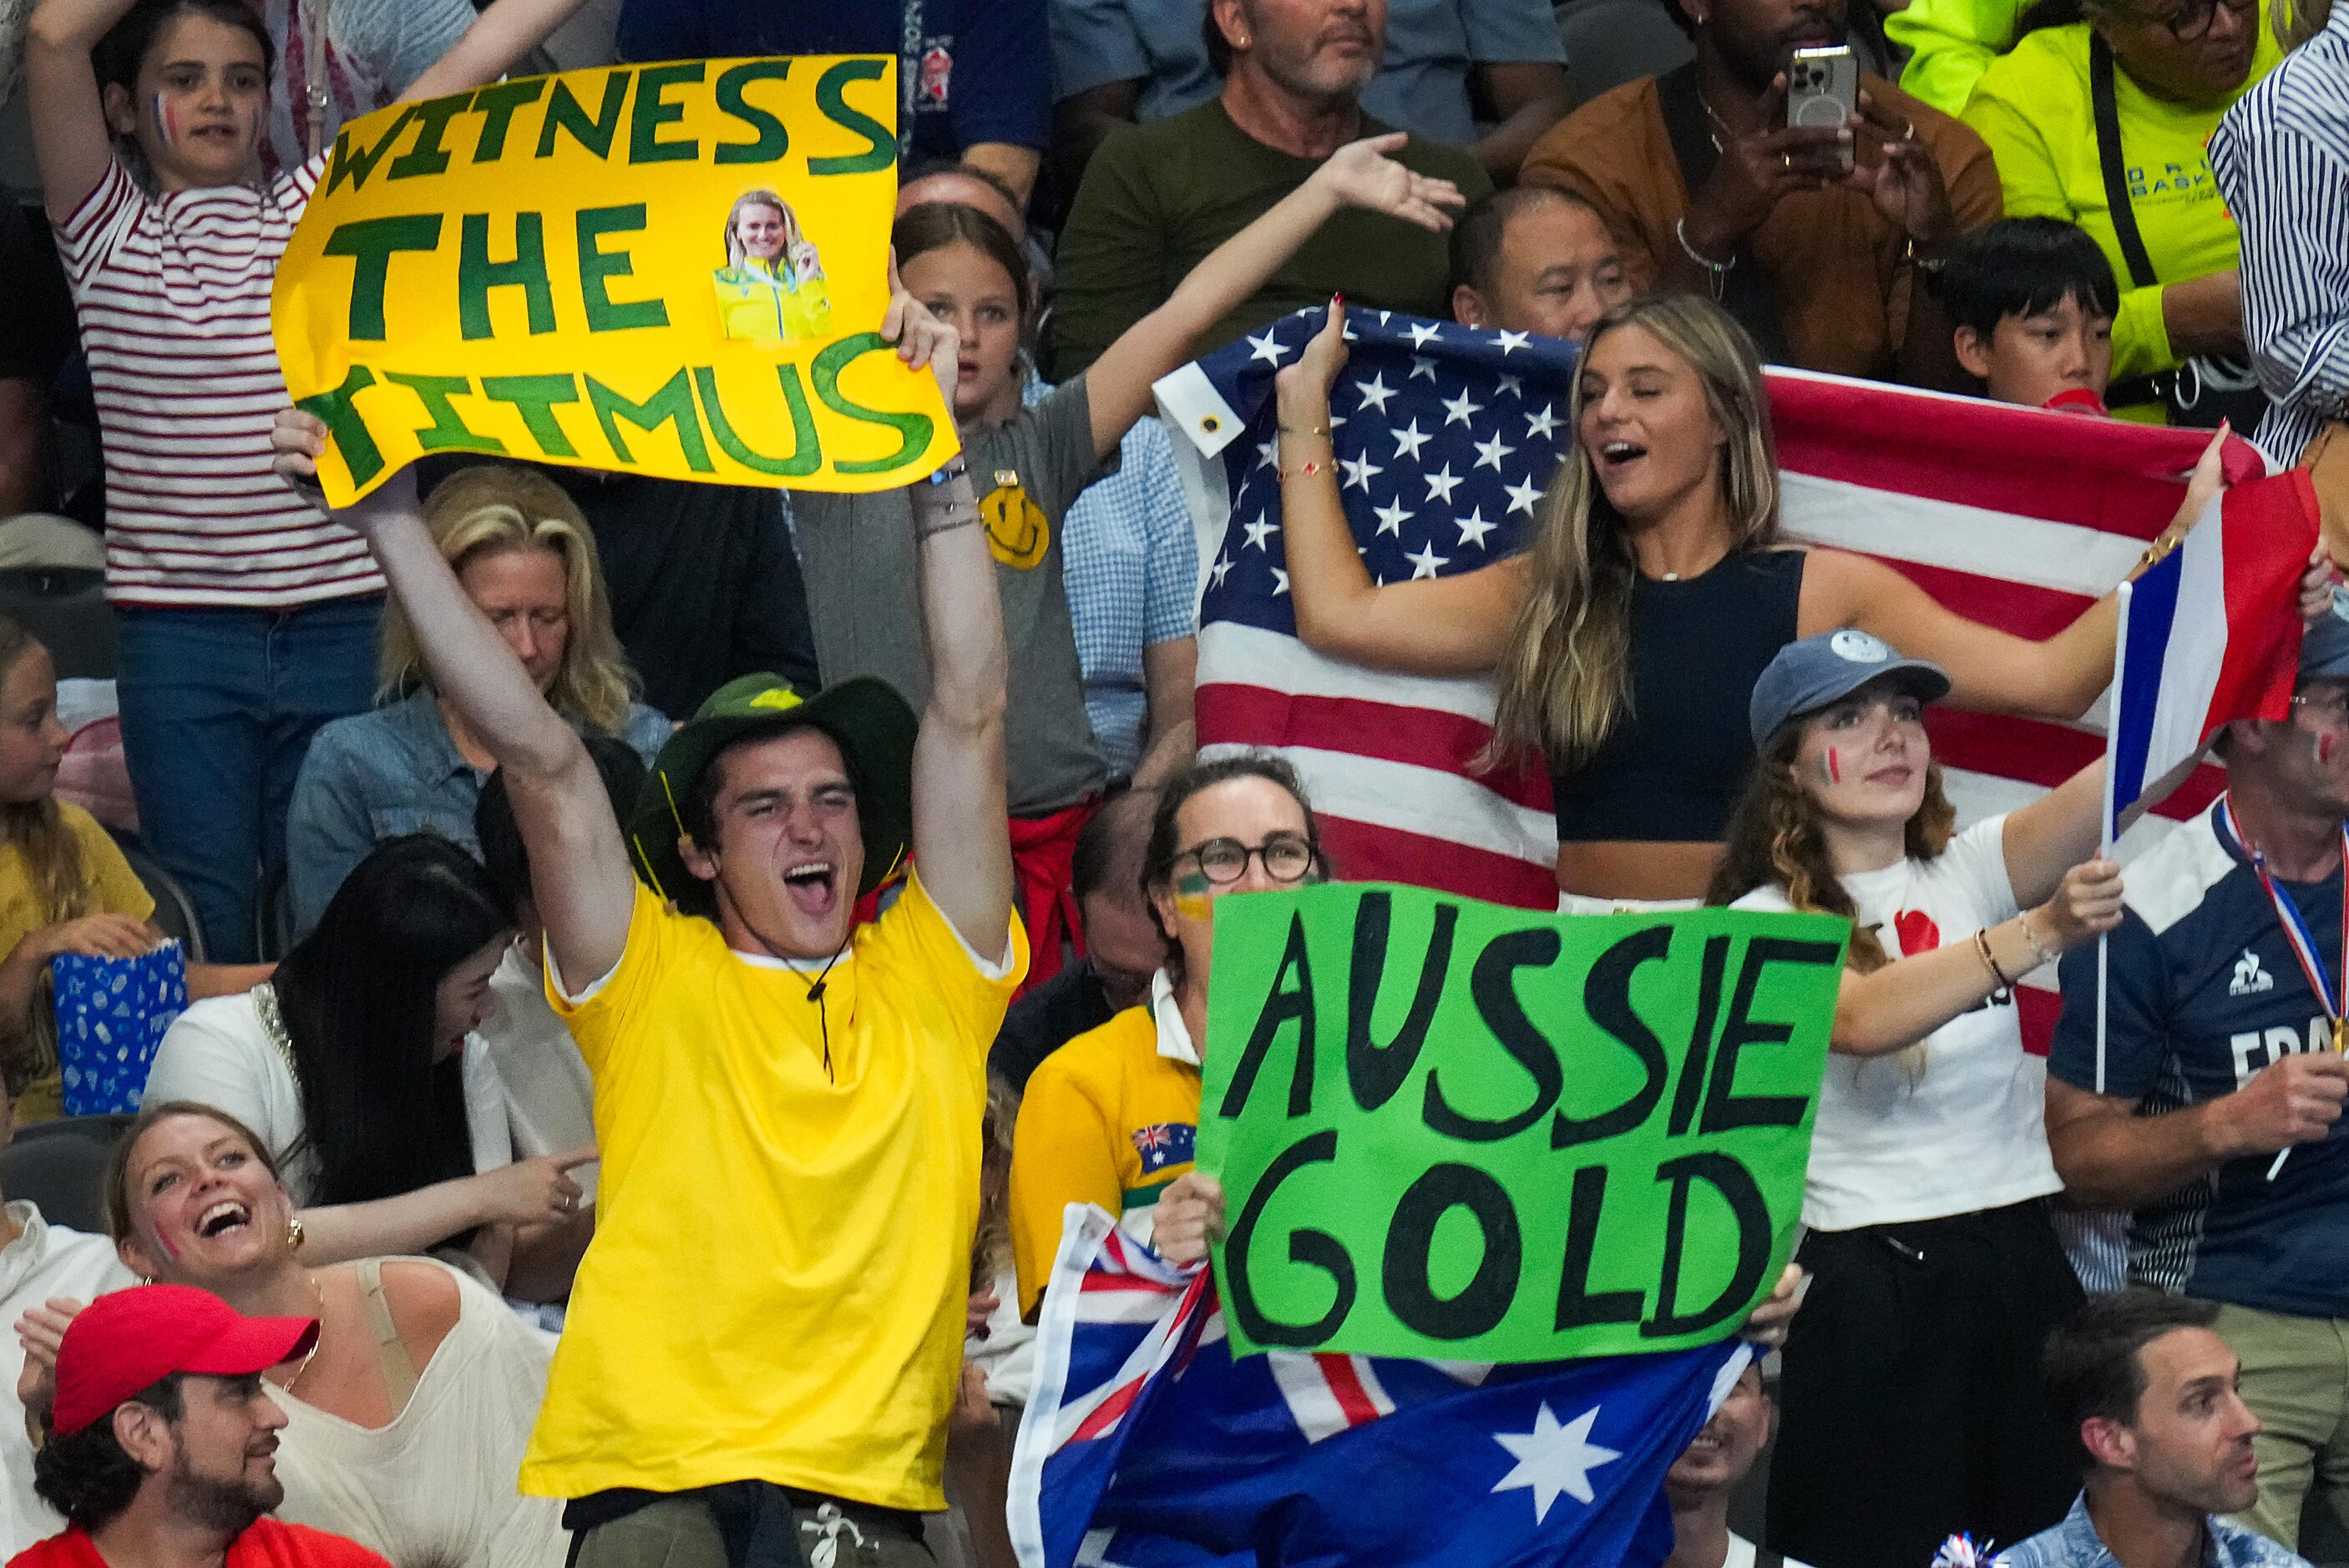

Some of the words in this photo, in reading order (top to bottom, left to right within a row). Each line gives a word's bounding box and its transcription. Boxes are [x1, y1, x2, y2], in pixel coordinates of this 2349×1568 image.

[326, 59, 898, 198] WITNESS
[322, 201, 671, 341] THE
[294, 331, 934, 492] TITMUS
[1219, 891, 1842, 1150] AUSSIE
[1224, 1129, 1772, 1348] GOLD
